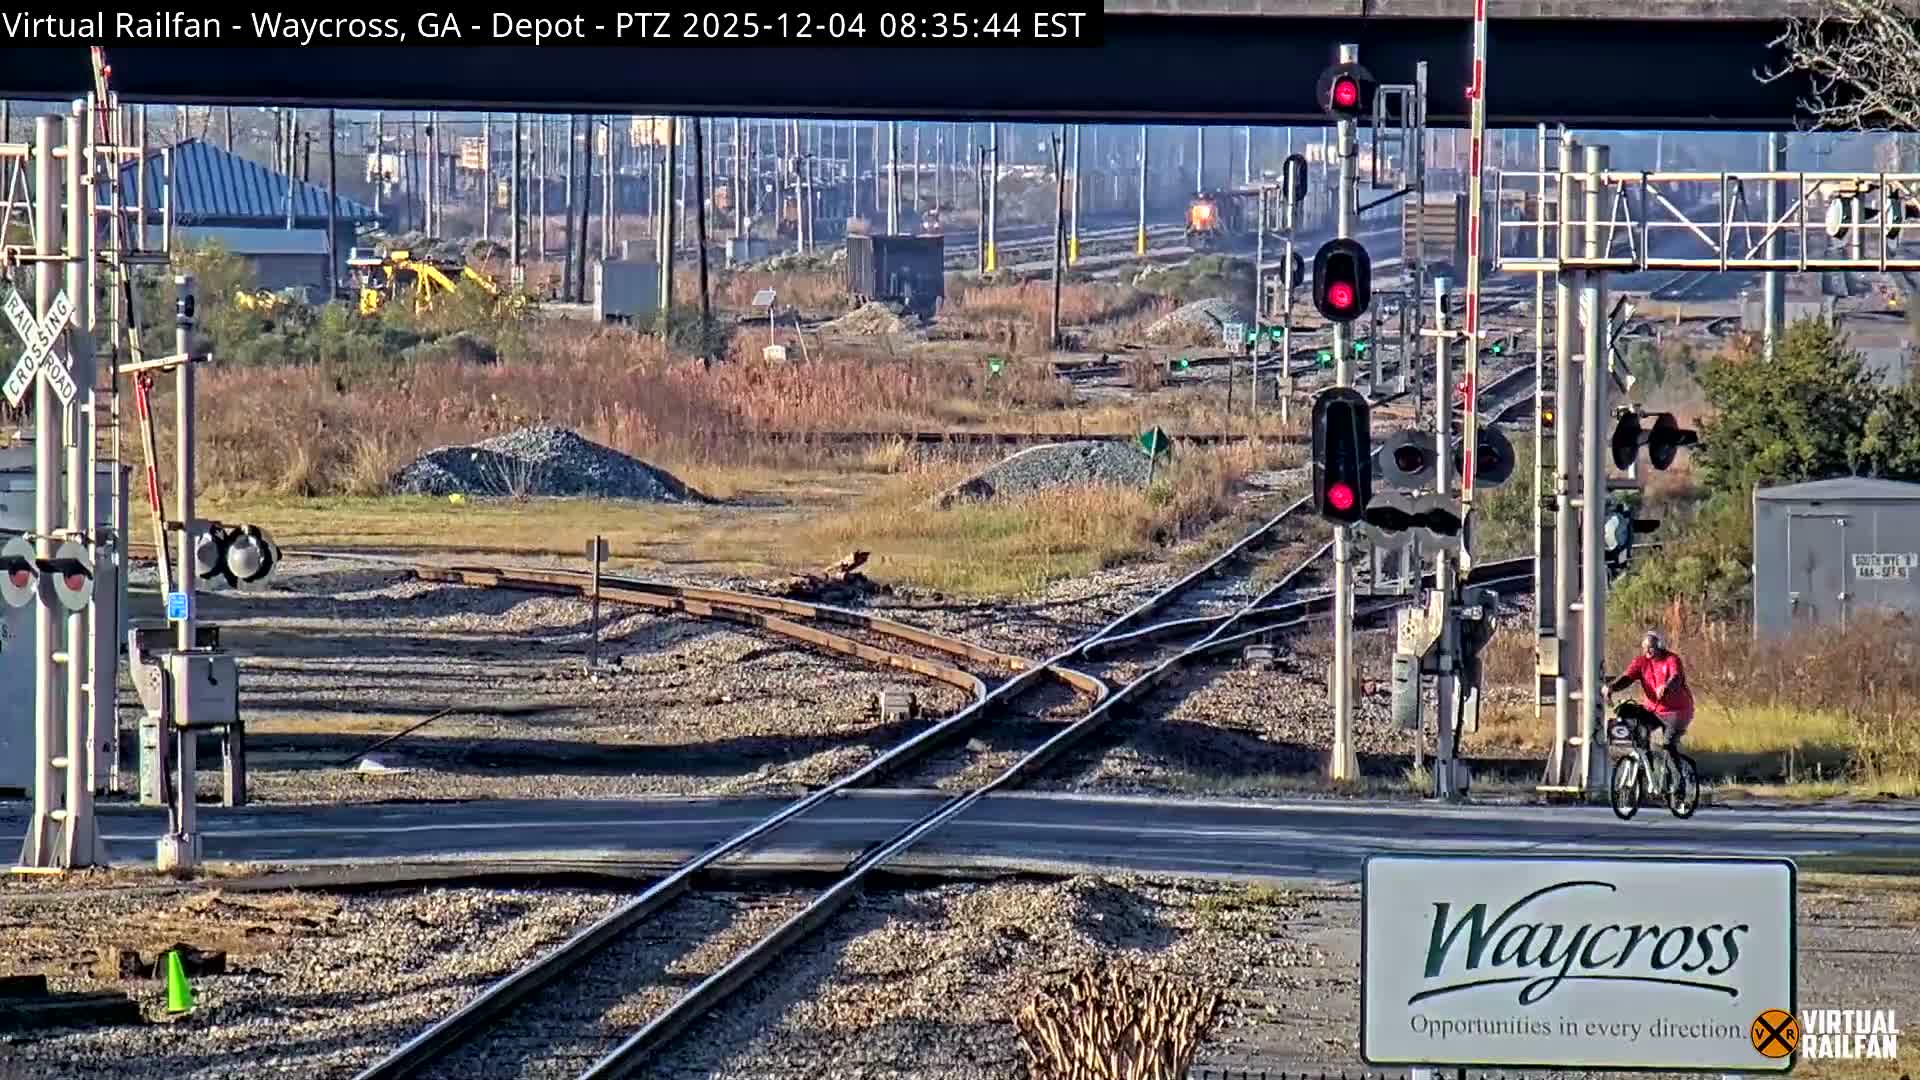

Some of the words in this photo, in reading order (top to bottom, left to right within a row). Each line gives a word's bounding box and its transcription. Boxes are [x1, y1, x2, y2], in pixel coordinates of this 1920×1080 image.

[8, 296, 33, 341] RAIL
[44, 354, 73, 399] ROAD
[9, 300, 67, 396] CROSSING
[1423, 880, 1750, 1006] Waycross
[1410, 1014, 1552, 1040] Opportunities
[1559, 1015, 1579, 1037] in
[1584, 1020, 1643, 1042] every
[1649, 1016, 1750, 1041] direction.
